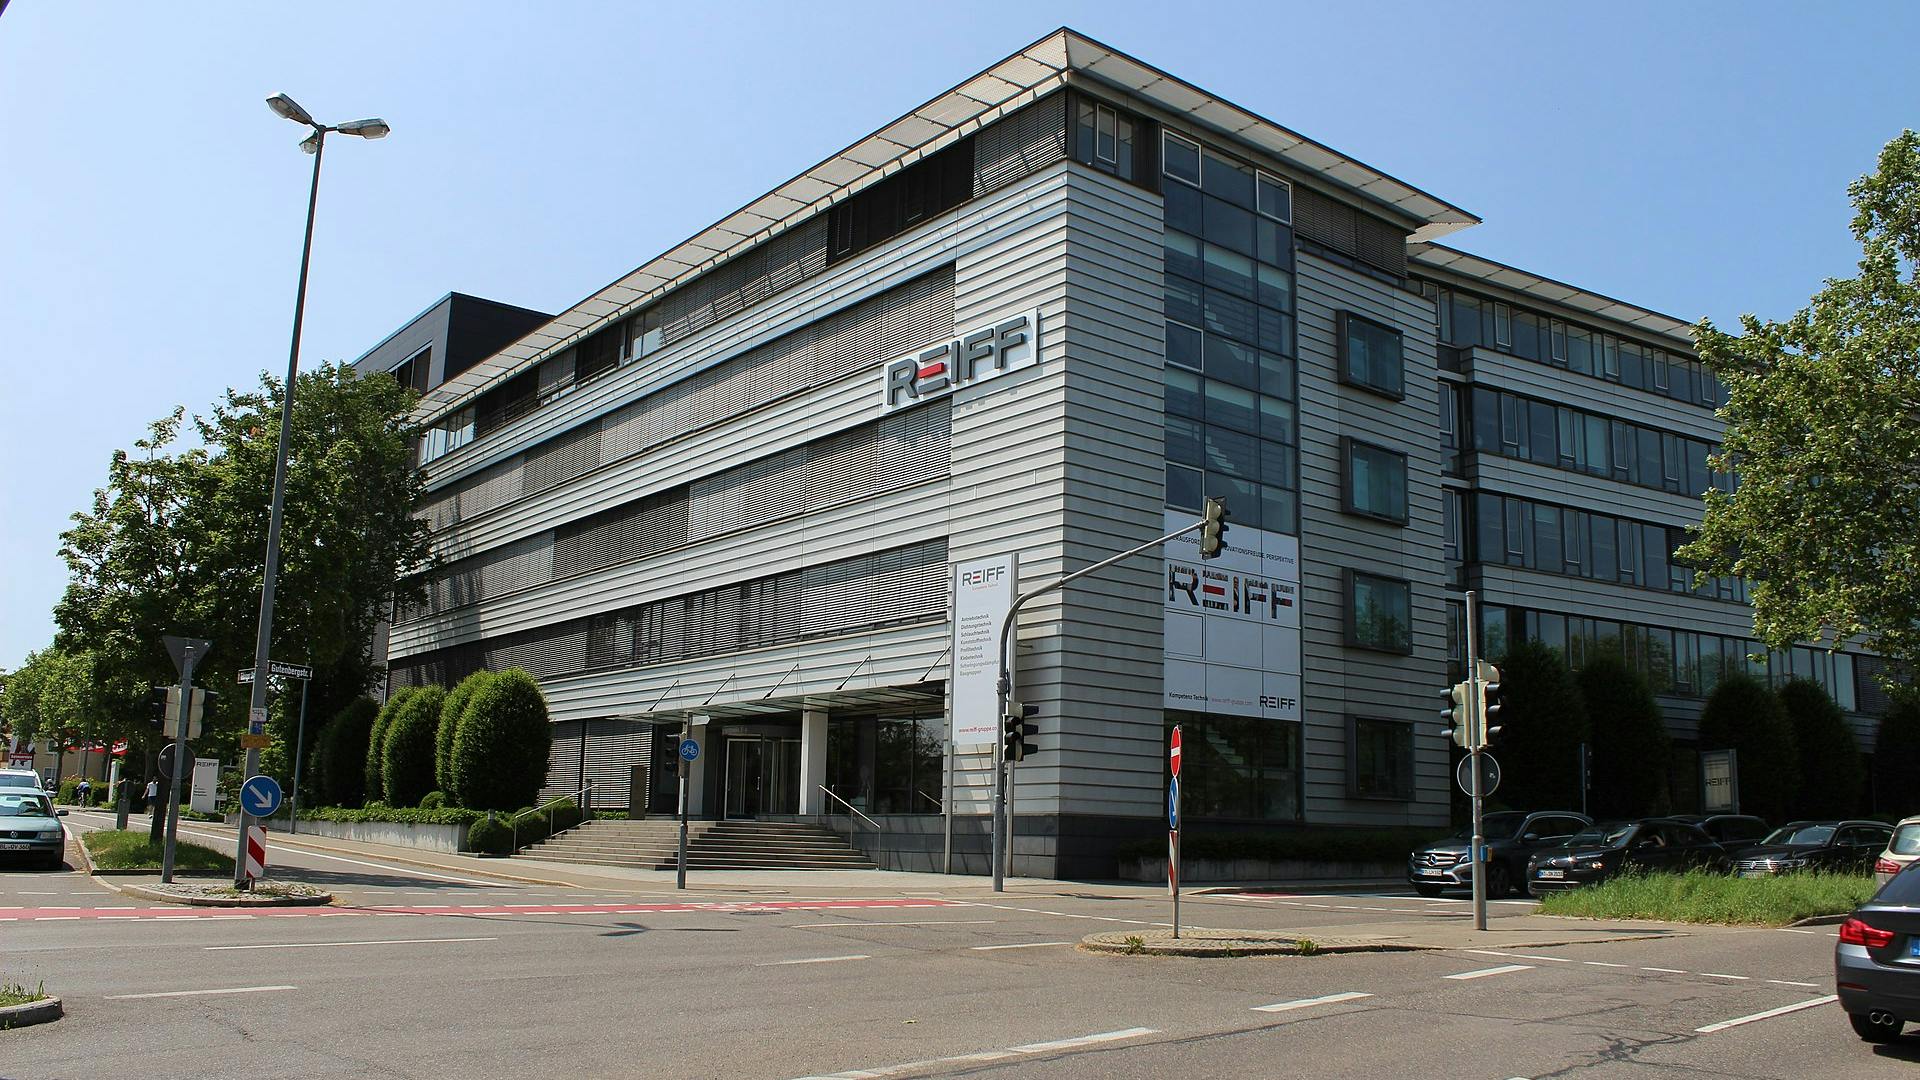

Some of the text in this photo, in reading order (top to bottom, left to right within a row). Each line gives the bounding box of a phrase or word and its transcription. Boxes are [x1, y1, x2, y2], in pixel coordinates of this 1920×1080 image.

[887, 316, 1027, 405] REIFF
[962, 566, 1005, 586] REIFF
[1169, 564, 1294, 619] REIFF
[271, 663, 309, 678] Gutenbergstr.
[1260, 695, 1296, 710] REIFF
